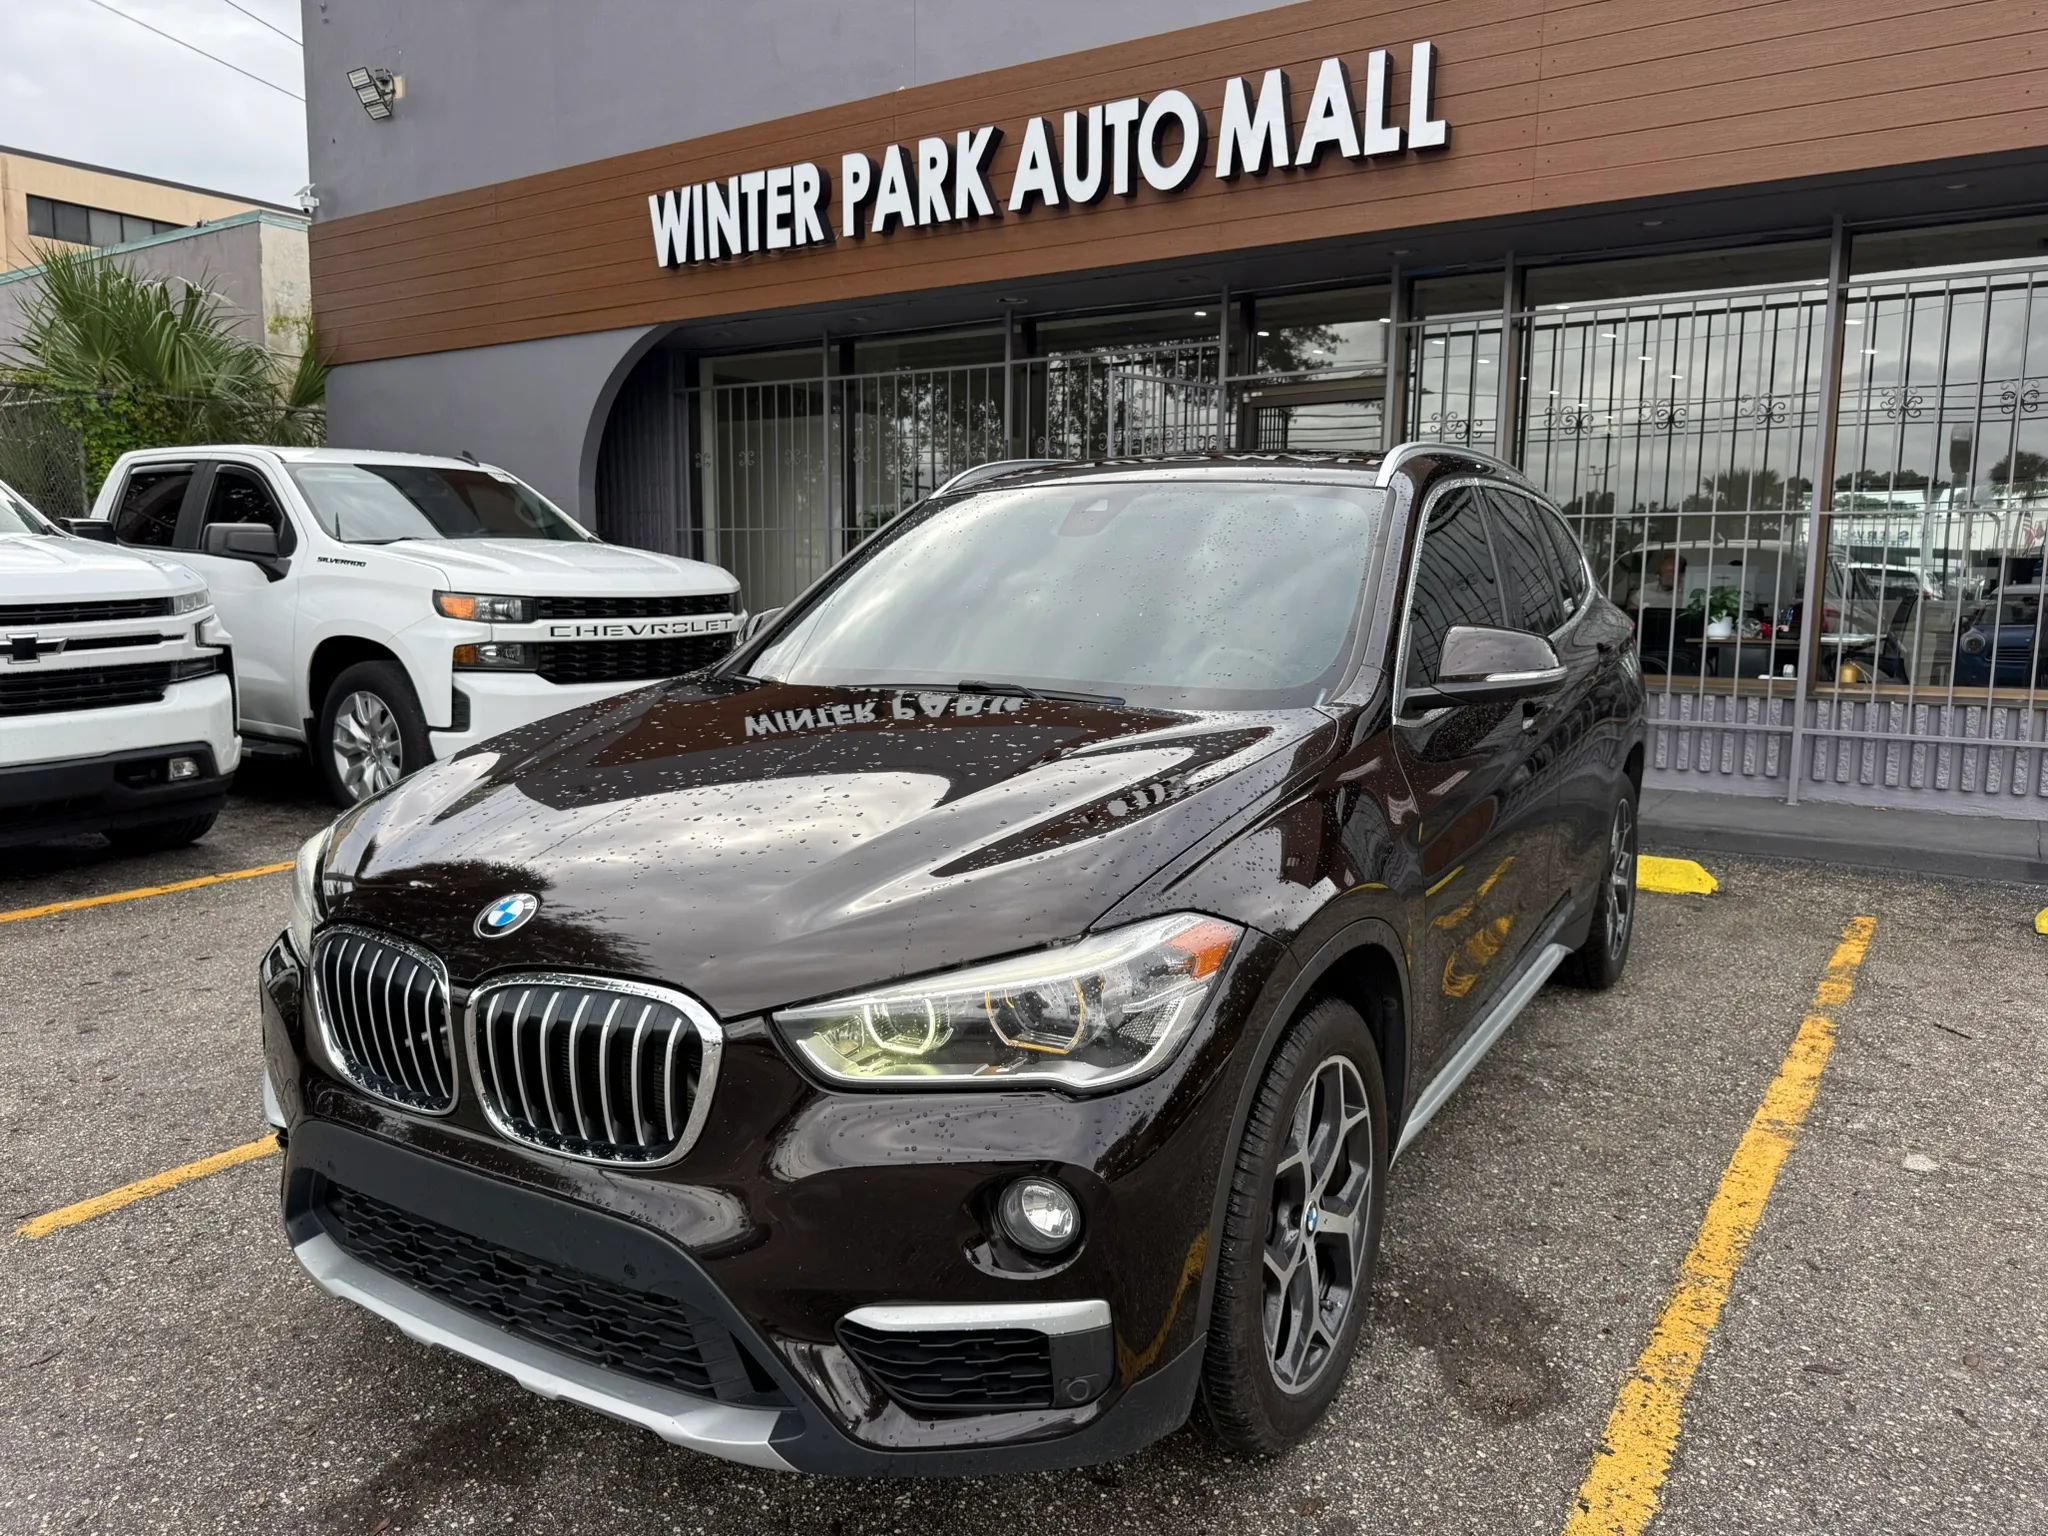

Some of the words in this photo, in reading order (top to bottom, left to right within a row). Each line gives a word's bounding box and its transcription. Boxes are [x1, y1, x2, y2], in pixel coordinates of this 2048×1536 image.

[648, 161, 825, 268] WINTER
[842, 125, 996, 238] PARK
[1008, 89, 1201, 211] AUTO
[1216, 40, 1447, 179] MALL
[317, 556, 367, 567] SILVERADO
[550, 619, 732, 638] CHEVROLET
